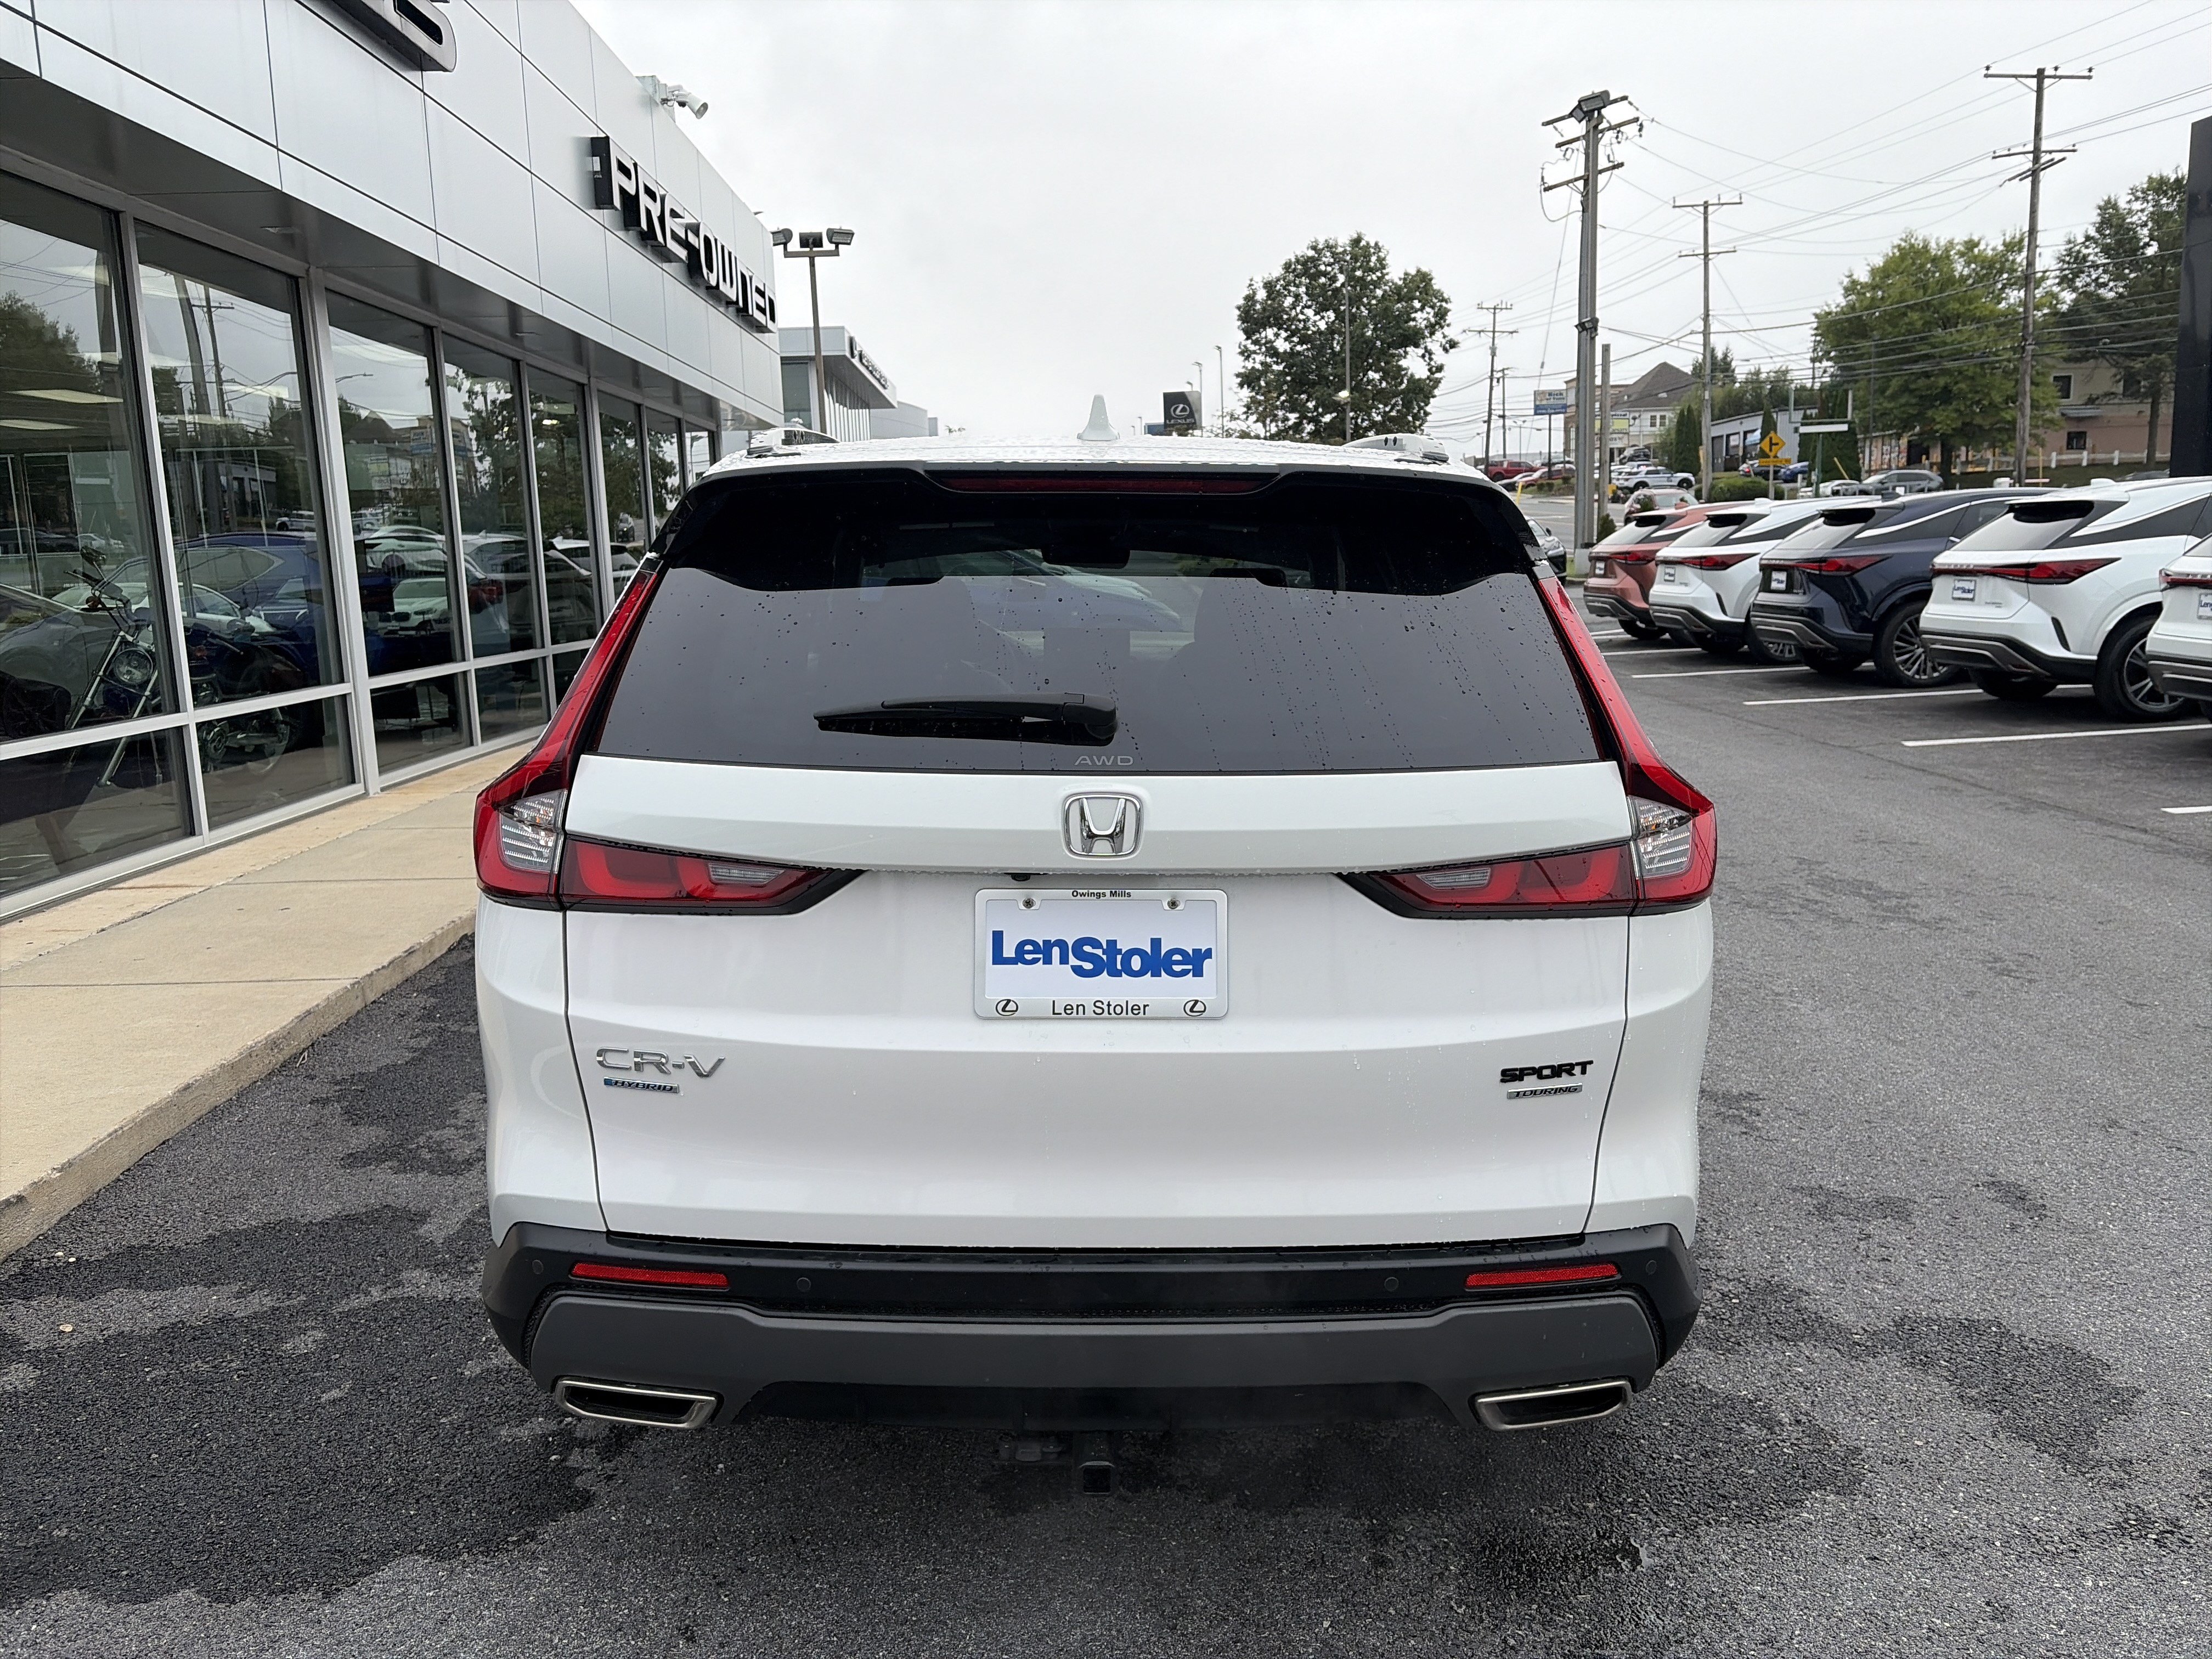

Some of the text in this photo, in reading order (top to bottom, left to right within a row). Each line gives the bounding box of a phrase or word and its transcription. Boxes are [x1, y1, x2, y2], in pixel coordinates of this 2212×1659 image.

[608, 137, 778, 333] PRE-OWNED
[1074, 755, 1133, 765] AWD
[1071, 890, 1132, 899] Owings Mills
[1052, 1000, 1149, 1015] Len Stoler
[596, 1046, 726, 1077] CR-V
[1500, 1060, 1594, 1083] SPORT
[613, 1080, 674, 1092] HYBRID
[1514, 1087, 1579, 1098] TOURING
